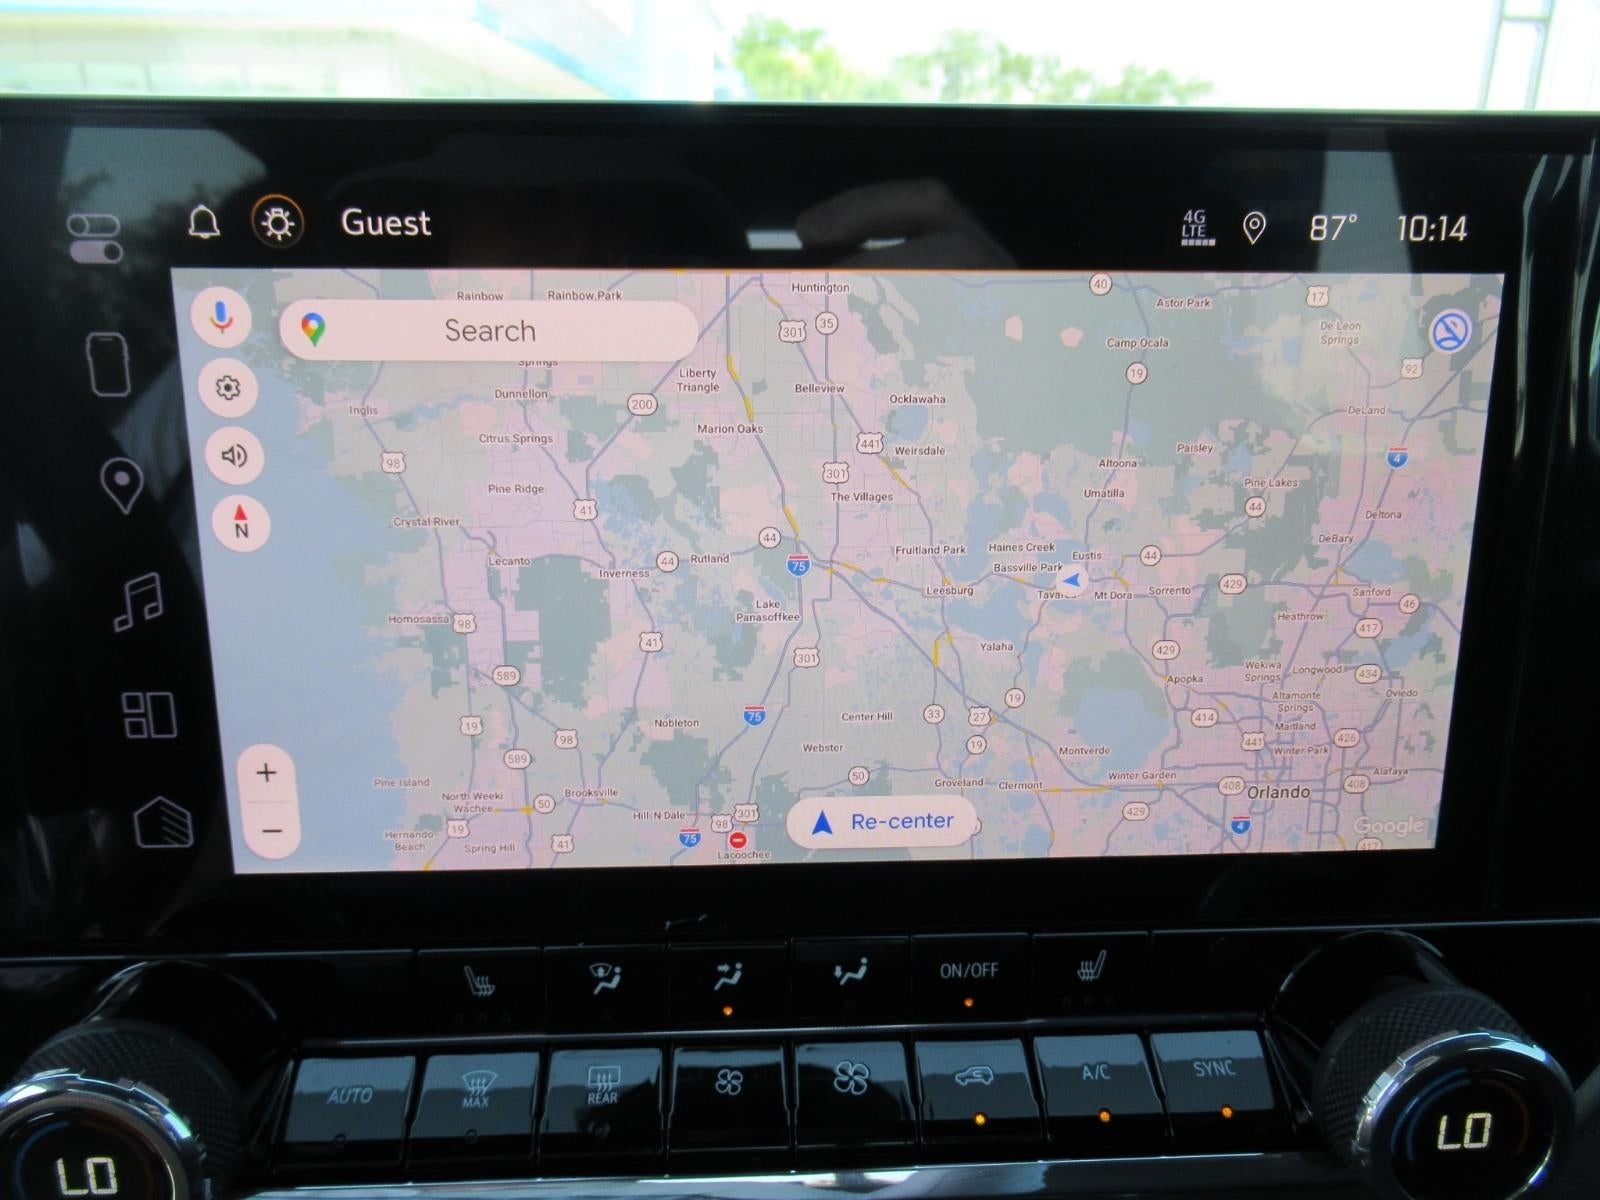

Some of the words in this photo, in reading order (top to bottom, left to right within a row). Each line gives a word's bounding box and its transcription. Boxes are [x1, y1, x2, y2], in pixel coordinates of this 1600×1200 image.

[1184, 210, 1206, 223] 4G
[341, 208, 432, 237] Guest
[1182, 225, 1206, 237] LTE
[1310, 214, 1358, 241] 87°
[1398, 215, 1468, 242] 10:14
[792, 283, 850, 294] Huntington
[1094, 279, 1107, 289] 40
[457, 291, 503, 300] Rainbow
[548, 290, 595, 300] Rainbow
[598, 291, 622, 300] Park
[1312, 292, 1324, 302] 17
[1157, 299, 1183, 308] Astor
[1187, 299, 1210, 307] Park
[820, 319, 834, 328] 35
[1321, 321, 1333, 331] De
[1337, 321, 1361, 331] Leon
[445, 318, 536, 342] Search
[783, 328, 803, 337] 301
[1107, 338, 1137, 349] Camp
[1140, 338, 1169, 348] Ocala
[1321, 335, 1359, 346] Springs
[679, 368, 716, 379] Liberty
[1130, 368, 1143, 378] 19
[1405, 364, 1418, 374] 92
[677, 382, 720, 394] Triangle
[795, 384, 845, 393] Belleview
[495, 389, 548, 399] Dunnellon
[890, 394, 946, 404] Ocklawaha
[632, 400, 653, 410] 200
[349, 405, 378, 417] Inglis
[1348, 406, 1386, 415] DeLand
[698, 424, 734, 434] Marion
[737, 424, 764, 434] Oaks
[479, 434, 510, 443] Citrus
[513, 434, 553, 445] Springs
[861, 439, 880, 449] 441
[895, 446, 945, 456] Weirsdale
[1177, 444, 1213, 454] Paisley
[1394, 454, 1400, 463] 4
[386, 459, 400, 468] 98
[1099, 459, 1137, 468] Altoona
[826, 469, 846, 479] 301
[1244, 479, 1266, 487] Pine
[1269, 479, 1298, 487] Lakes
[488, 484, 511, 493] Pine
[515, 484, 544, 495] Ridge
[1084, 489, 1124, 498] Umatilla
[831, 492, 850, 501] The
[853, 492, 893, 503] Villages
[580, 506, 592, 515] 41
[1249, 502, 1262, 511] 44
[1366, 510, 1402, 519] Deltona
[393, 518, 431, 528] Crystal
[434, 517, 460, 526] River
[235, 523, 248, 538] N
[763, 533, 777, 542] 44
[1319, 534, 1354, 544] DeBary
[896, 545, 940, 555] Fruitland
[943, 545, 966, 554] Park
[989, 543, 1023, 552] Haines
[1026, 543, 1055, 551] Creek
[691, 554, 730, 564] Rutland
[1072, 551, 1102, 560] Eustis
[1144, 551, 1157, 560] 44
[488, 557, 530, 566] Lecanto
[661, 557, 674, 566] 44
[792, 562, 806, 571] 75
[994, 563, 1037, 573] Bassville
[1040, 563, 1063, 573] Park
[600, 569, 650, 578] Inverness
[1223, 579, 1243, 589] 429
[927, 586, 973, 597] Leesburg
[1038, 590, 1077, 599] Tavar
[1095, 591, 1106, 599] Mt
[1109, 591, 1132, 599] Dora
[1149, 586, 1191, 595] Sorrento
[1353, 588, 1391, 597] Sanford
[756, 600, 780, 609] Lake
[1403, 599, 1415, 608] 46
[388, 615, 449, 624] Homosassa
[737, 613, 800, 622] Panasoffkee
[1278, 612, 1324, 621] Heathrow
[457, 620, 471, 629] 98
[1359, 623, 1377, 633] 417
[645, 639, 658, 647] 41
[981, 642, 1013, 651] Yalaha
[1156, 645, 1175, 655] 429
[797, 654, 816, 663] 301
[1245, 661, 1282, 670] Wekiwa
[1292, 666, 1342, 675] Longwood
[1358, 669, 1377, 678] 434
[496, 671, 516, 680] 589
[1167, 675, 1204, 684] Apopka
[1244, 673, 1281, 683] Springs
[1009, 693, 1020, 702] 19
[1272, 692, 1321, 700] Altamonte
[1386, 689, 1418, 698] Oviedo
[1278, 703, 1313, 714] Springs
[748, 711, 762, 721] 75
[842, 712, 874, 721] Center
[877, 712, 893, 720] Hill
[927, 710, 940, 719] 33
[973, 712, 986, 722] 27
[1195, 713, 1214, 722] 414
[466, 722, 477, 731] 19
[655, 719, 699, 727] Nobleton
[1275, 722, 1316, 731] Maitland
[559, 735, 573, 745] 98
[1245, 738, 1263, 747] 441
[1338, 734, 1356, 742] 426
[803, 744, 843, 752] Webster
[971, 741, 983, 749] 19
[1060, 746, 1110, 755] Montverde
[1274, 747, 1304, 755] Winter
[1308, 746, 1328, 755] Park
[508, 754, 527, 763] 589
[852, 771, 865, 781] 50
[1109, 772, 1138, 780] Winter
[1142, 771, 1176, 780] Garden
[1373, 767, 1408, 776] Alafaya
[374, 779, 397, 787] Pine
[400, 778, 430, 787] Island
[935, 778, 983, 787] Groveland
[999, 781, 1042, 790] Clermont
[1222, 781, 1241, 790] 408
[1347, 779, 1366, 789] 408
[443, 792, 470, 800] North
[473, 792, 503, 800] Weeki
[565, 789, 618, 797] Brooksville
[1247, 785, 1311, 800] Orlando
[454, 804, 493, 813] Wachee
[538, 800, 551, 809] 50
[633, 812, 648, 820] Hill
[663, 811, 685, 820] Dale
[738, 809, 756, 819] 301
[1127, 807, 1146, 816] 429
[715, 820, 728, 829] 98
[852, 813, 954, 830] Re-center
[1237, 821, 1243, 830] 4
[1354, 816, 1424, 836] Google
[452, 825, 464, 833] 19
[385, 831, 433, 839] Hernando
[684, 834, 696, 843] 75
[395, 843, 426, 851] Beach
[465, 844, 497, 854] Spring
[500, 843, 515, 852] Hill
[556, 841, 569, 849] 41
[718, 850, 770, 859] Lacoochee
[940, 961, 999, 979] ON/OFF
[1082, 1063, 1111, 1082] A/C
[1193, 1059, 1236, 1078] SYNC
[327, 1086, 373, 1105] AUTO
[588, 1091, 618, 1105] REAR
[462, 1097, 489, 1109] MAX
[1437, 1112, 1492, 1150] LO
[56, 1157, 118, 1196] LO
